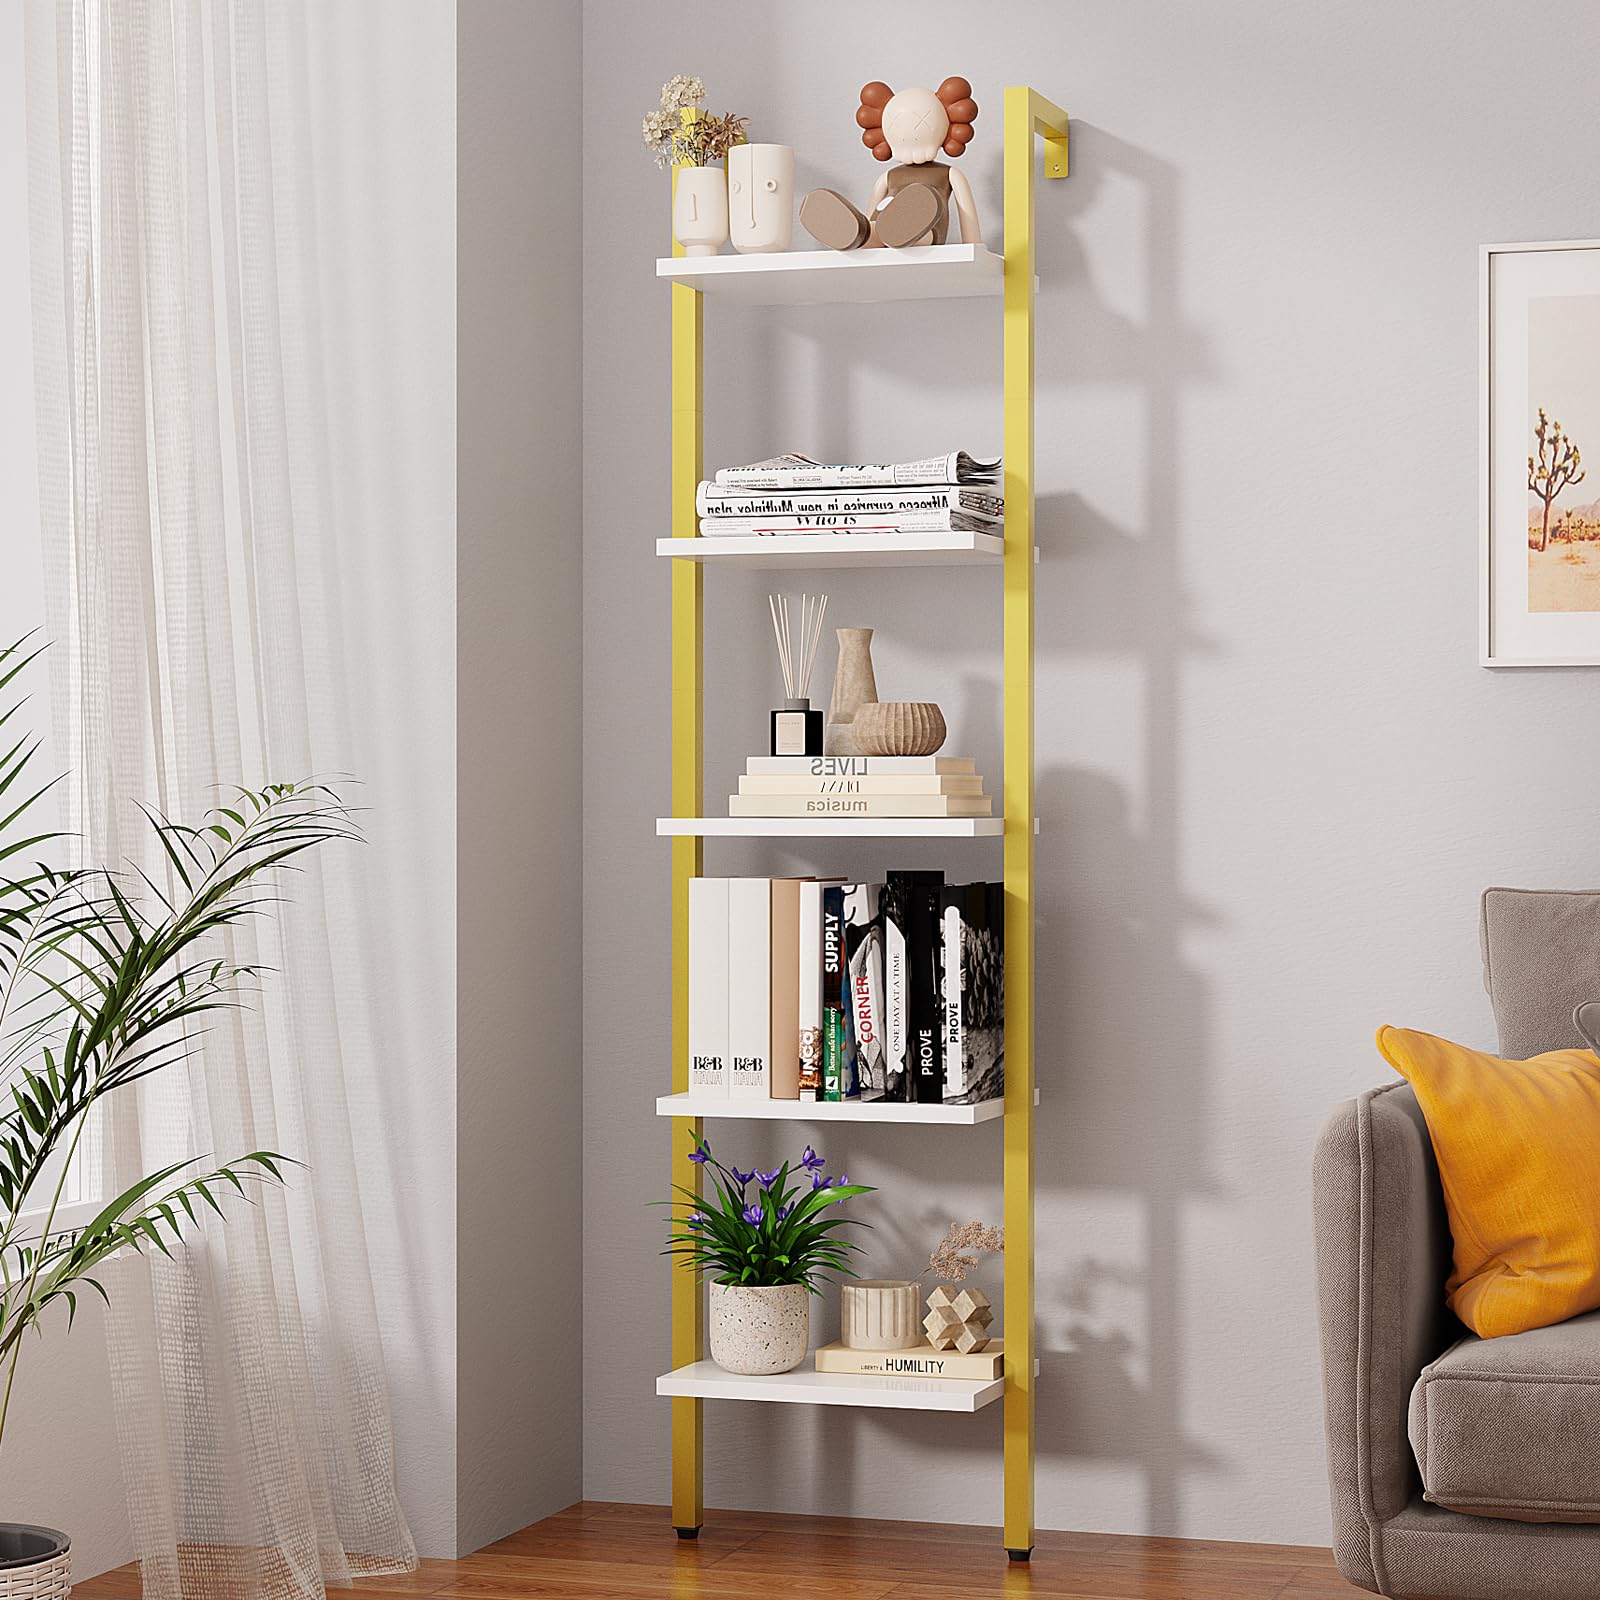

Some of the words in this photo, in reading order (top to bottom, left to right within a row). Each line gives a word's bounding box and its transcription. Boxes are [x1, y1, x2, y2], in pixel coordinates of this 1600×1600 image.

[825, 912, 839, 972] SUPPLY
[893, 988, 900, 1005] AT
[828, 1007, 837, 1023] sorry
[856, 976, 874, 1043] CORNER
[949, 1002, 958, 1043] PROVE
[828, 1024, 836, 1038] than
[828, 1039, 836, 1052] safe
[920, 1029, 933, 1076] PROVE
[693, 1056, 722, 1070] B&B
[734, 1057, 763, 1071] B&B
[828, 1053, 836, 1071] Better
[886, 1358, 944, 1374] HUMILITY
